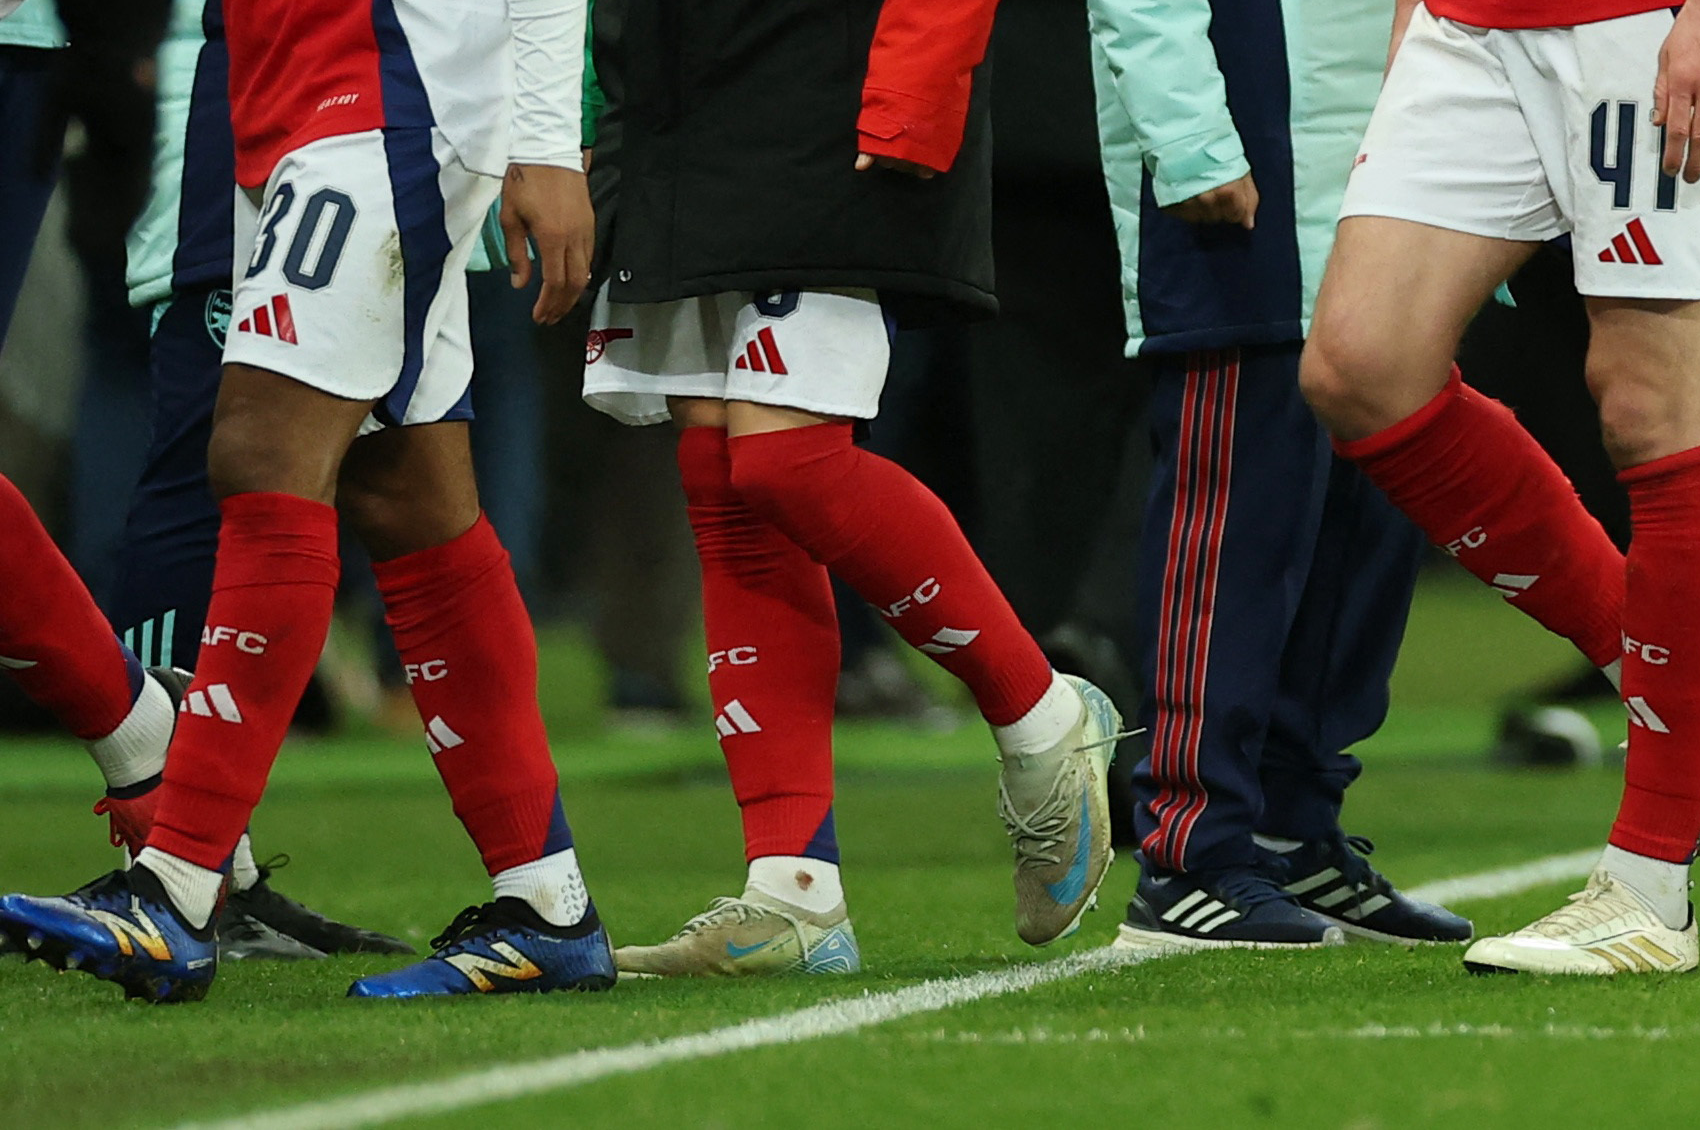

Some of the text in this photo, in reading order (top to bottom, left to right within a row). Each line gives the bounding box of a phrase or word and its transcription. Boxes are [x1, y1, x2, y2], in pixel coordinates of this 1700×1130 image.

[1446, 526, 1487, 556] FC
[881, 577, 941, 617] FC
[201, 624, 267, 655] AFC
[405, 659, 448, 685] FC
[708, 646, 757, 673] FC
